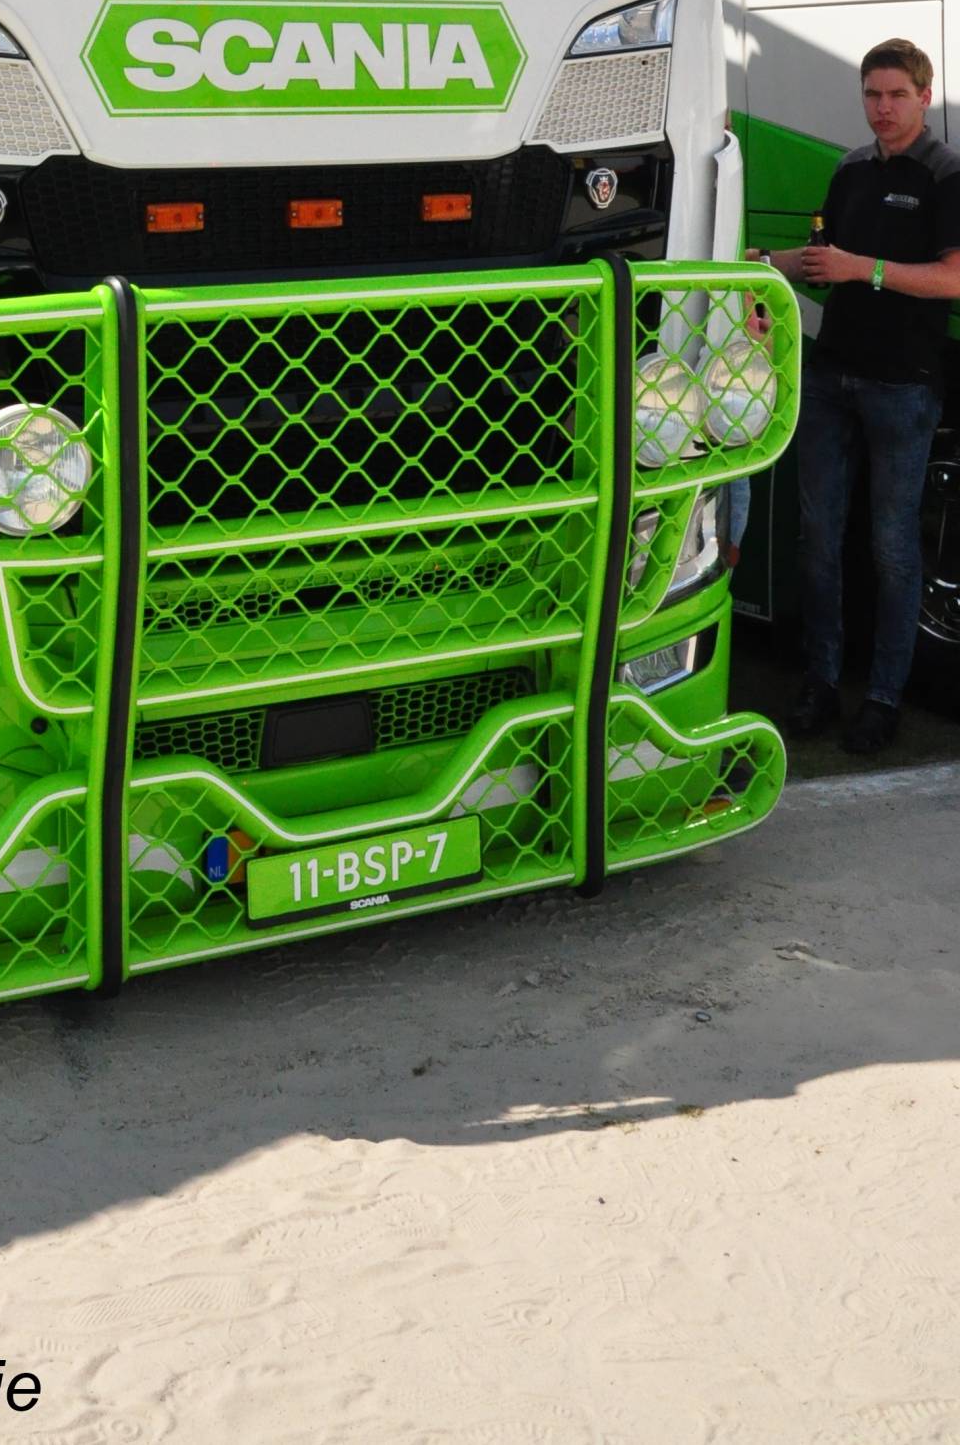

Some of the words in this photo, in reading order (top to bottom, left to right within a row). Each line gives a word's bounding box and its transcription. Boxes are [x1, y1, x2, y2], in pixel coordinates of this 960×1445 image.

[124, 17, 494, 92] SCANIA
[208, 865, 225, 879] NL
[289, 831, 448, 902] 11-BSP-7
[350, 894, 390, 910] SCANIA
